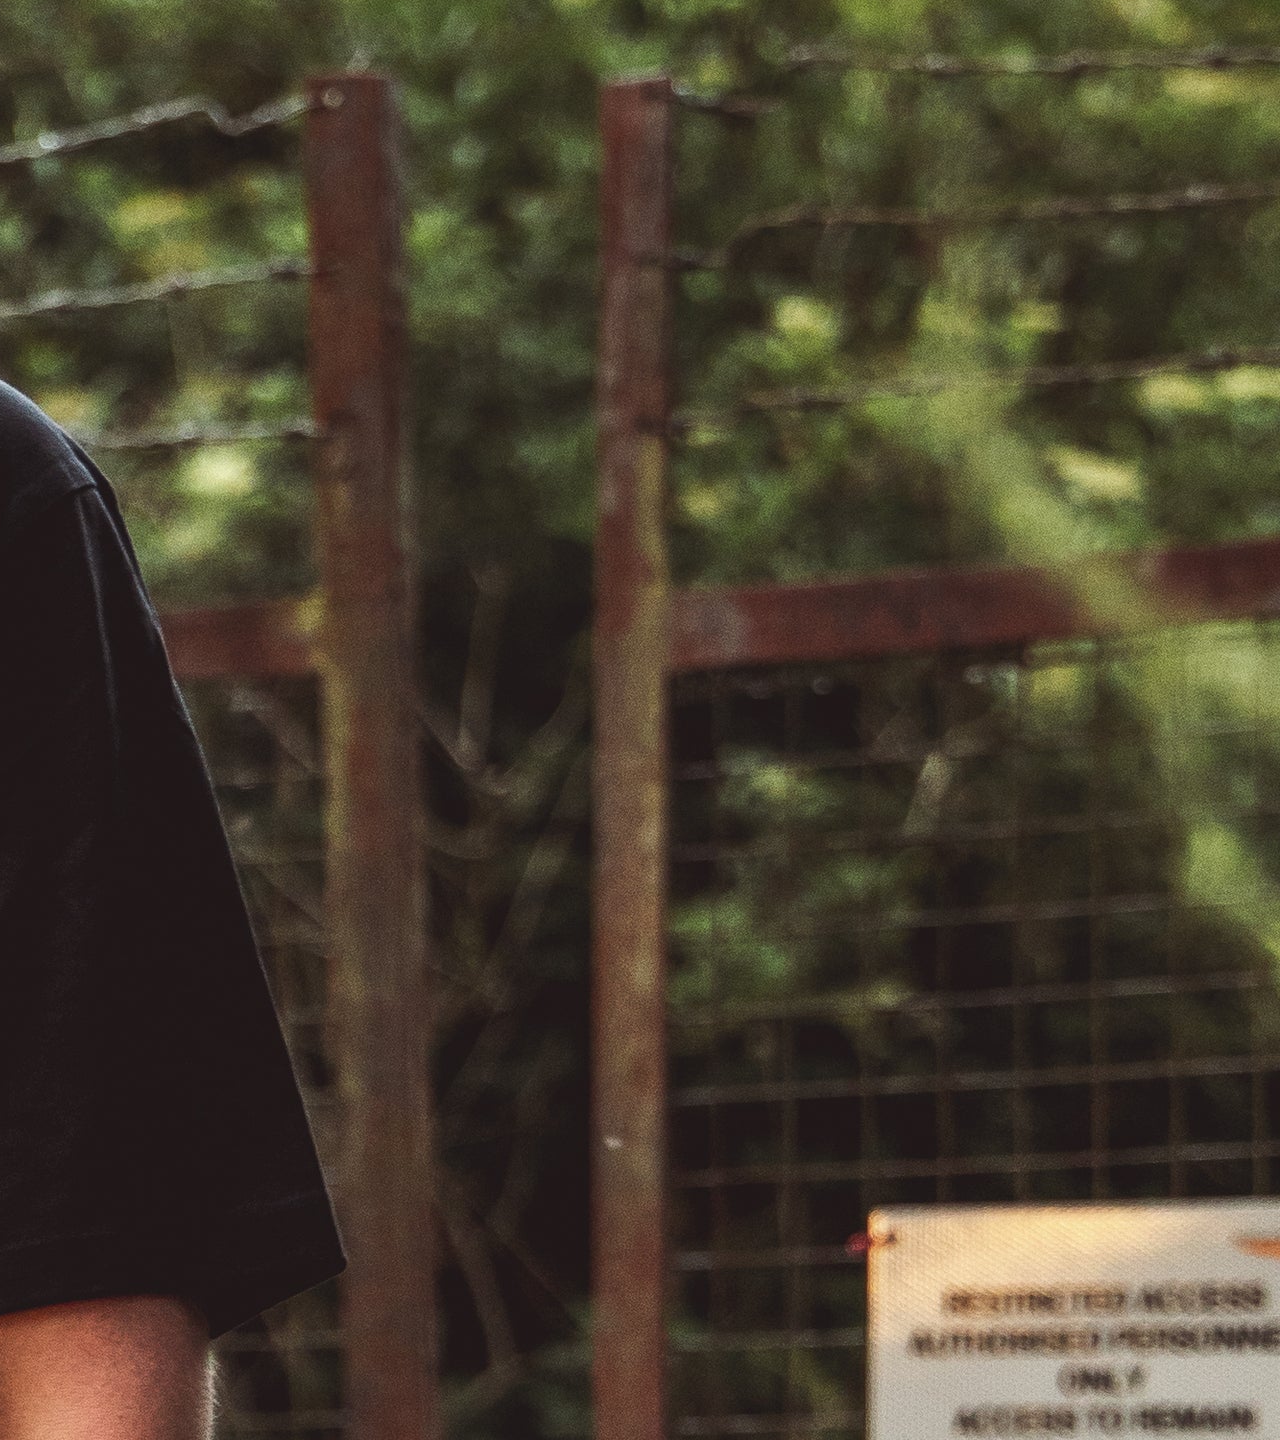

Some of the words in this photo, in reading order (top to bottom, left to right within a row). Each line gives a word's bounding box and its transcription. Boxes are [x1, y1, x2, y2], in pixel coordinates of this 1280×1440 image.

[943, 1284, 1127, 1316] RESTRICTED
[1137, 1279, 1266, 1312] ACCESS
[1109, 1320, 1280, 1353] PERSONNE
[1057, 1363, 1145, 1395] ONLY
[953, 1404, 1078, 1436] ACCESS
[1085, 1402, 1122, 1434] TO
[1132, 1401, 1256, 1434] REMAIN
